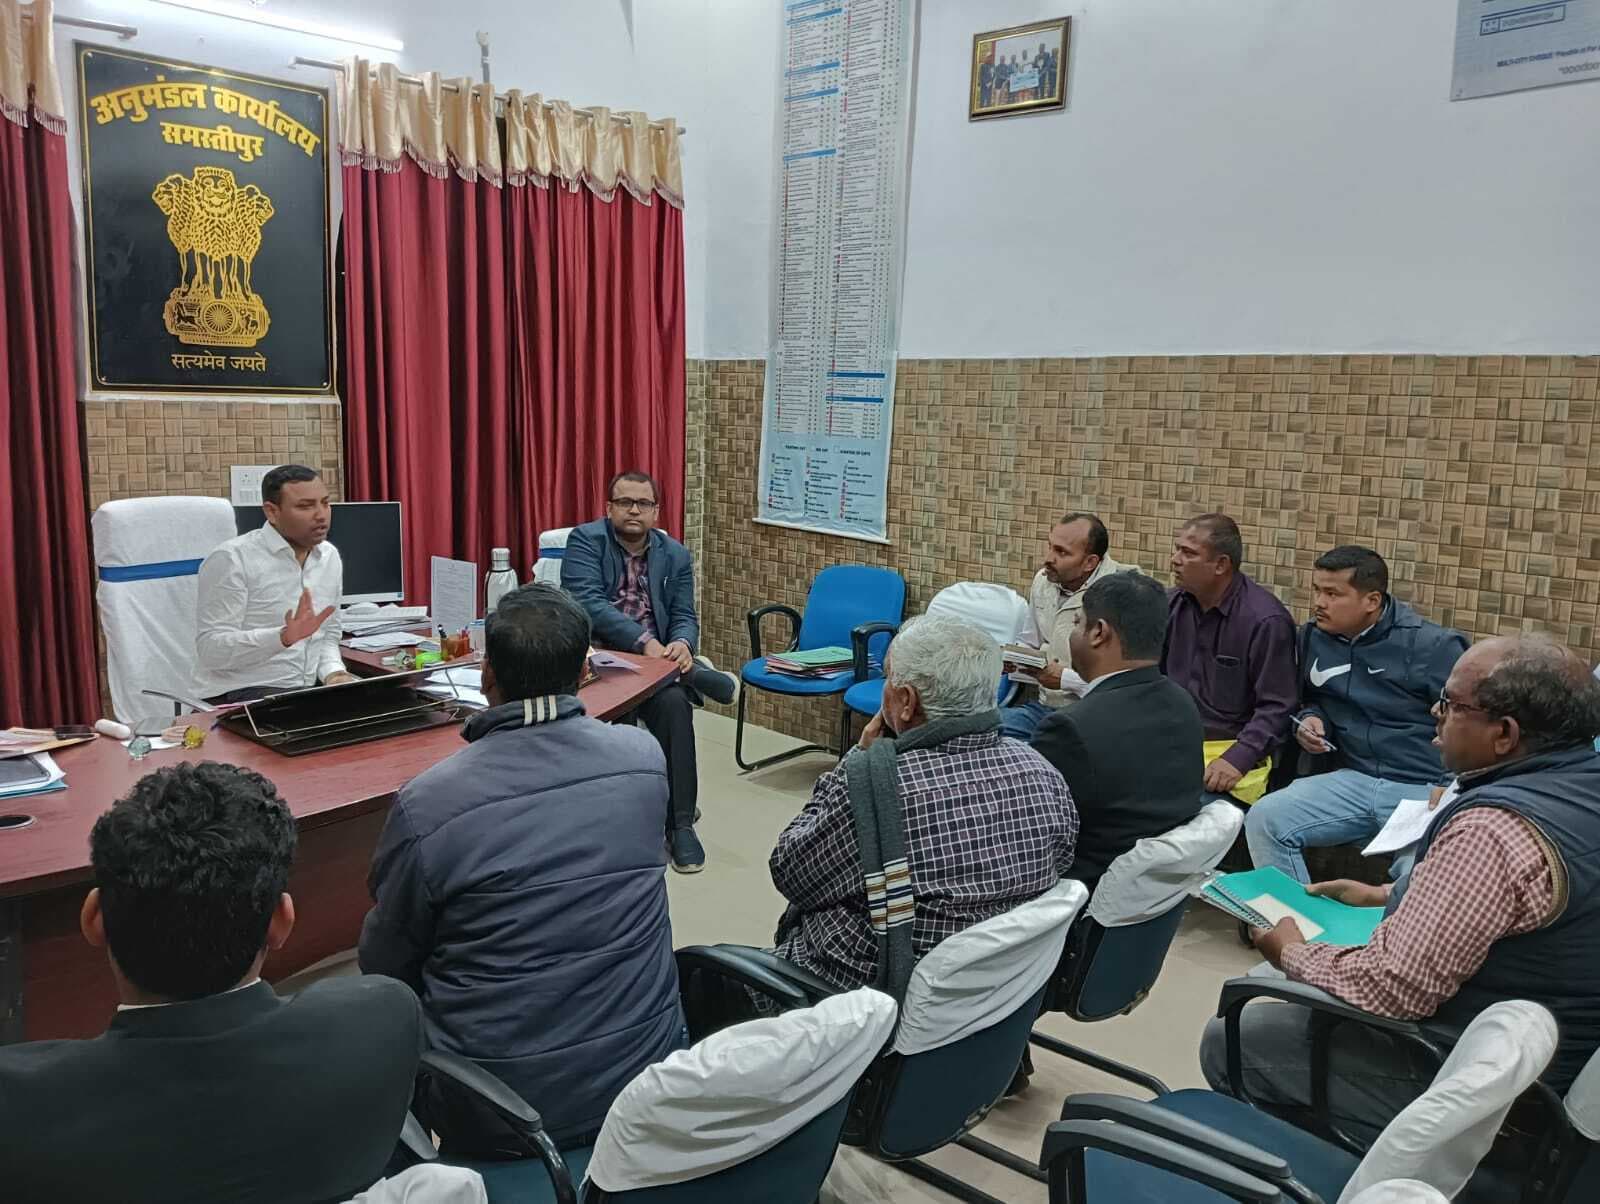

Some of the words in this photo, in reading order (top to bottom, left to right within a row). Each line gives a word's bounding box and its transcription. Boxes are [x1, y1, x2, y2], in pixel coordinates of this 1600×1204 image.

[91, 76, 207, 125] अनुमंडल
[211, 86, 321, 157] कार्यालय
[160, 123, 264, 160] समस्तीपुर
[171, 350, 226, 370] सत्यमेव
[230, 353, 266, 372] जयते
